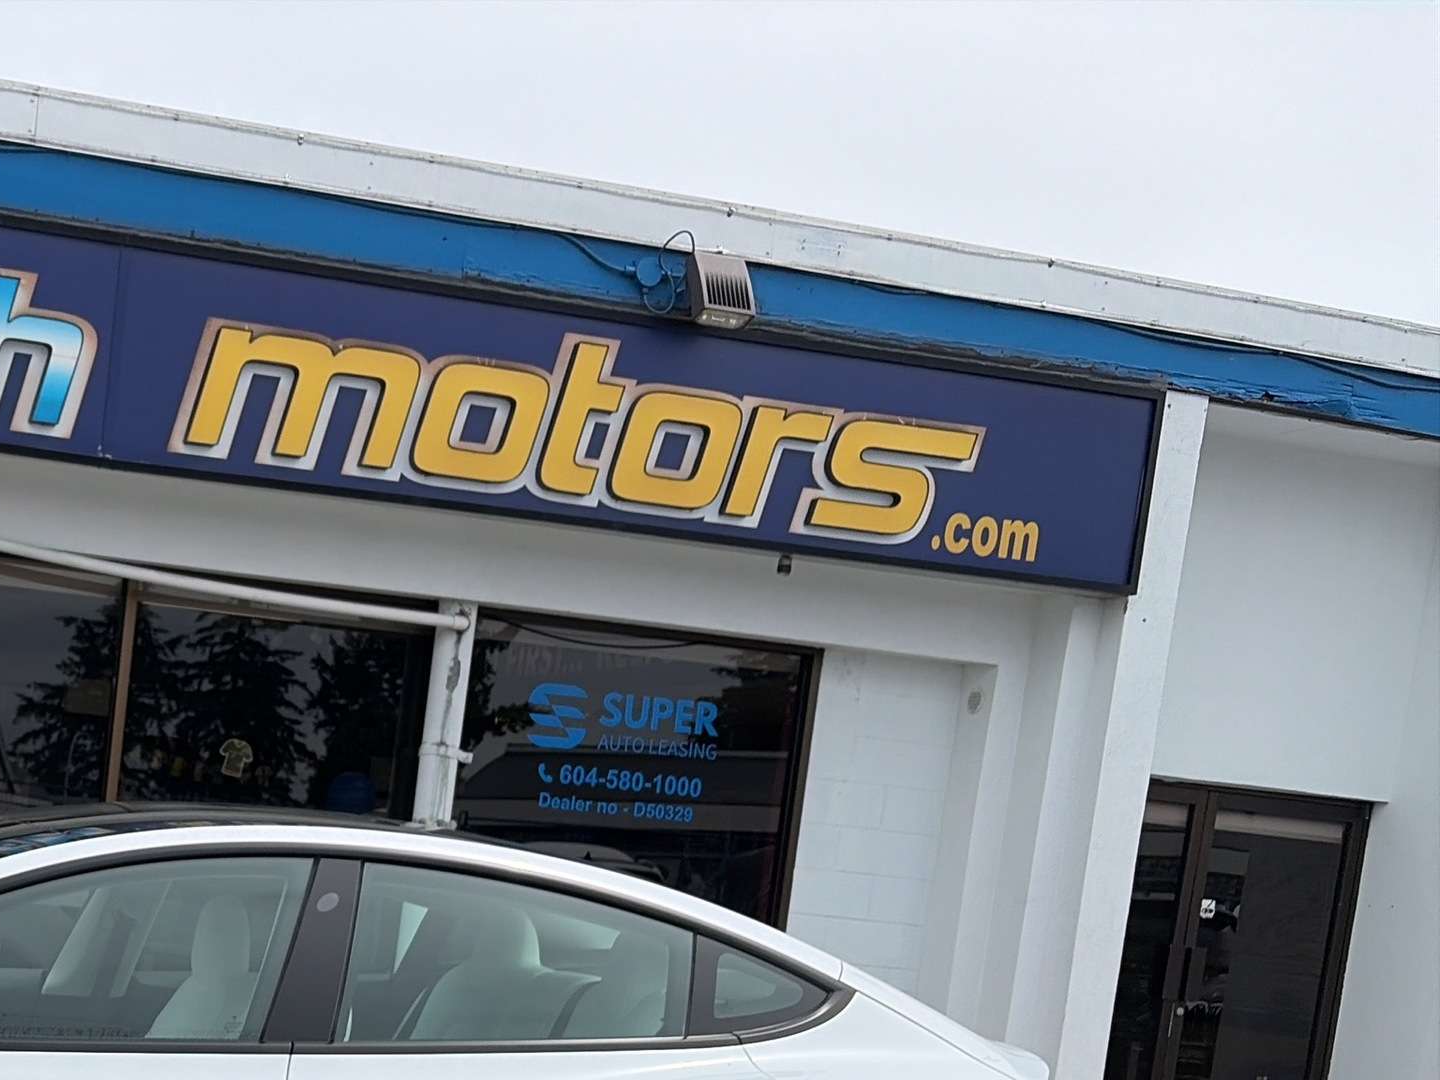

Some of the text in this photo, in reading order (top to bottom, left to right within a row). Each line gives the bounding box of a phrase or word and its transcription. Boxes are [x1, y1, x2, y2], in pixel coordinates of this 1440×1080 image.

[173, 321, 983, 542] motors
[930, 511, 1040, 563] .com
[600, 691, 718, 737] SUPER
[597, 734, 718, 761] AUTO LEASING
[560, 764, 702, 798] 604-580-1000
[538, 792, 591, 812] Dealer
[596, 801, 620, 816] no
[633, 801, 695, 824] D50329
